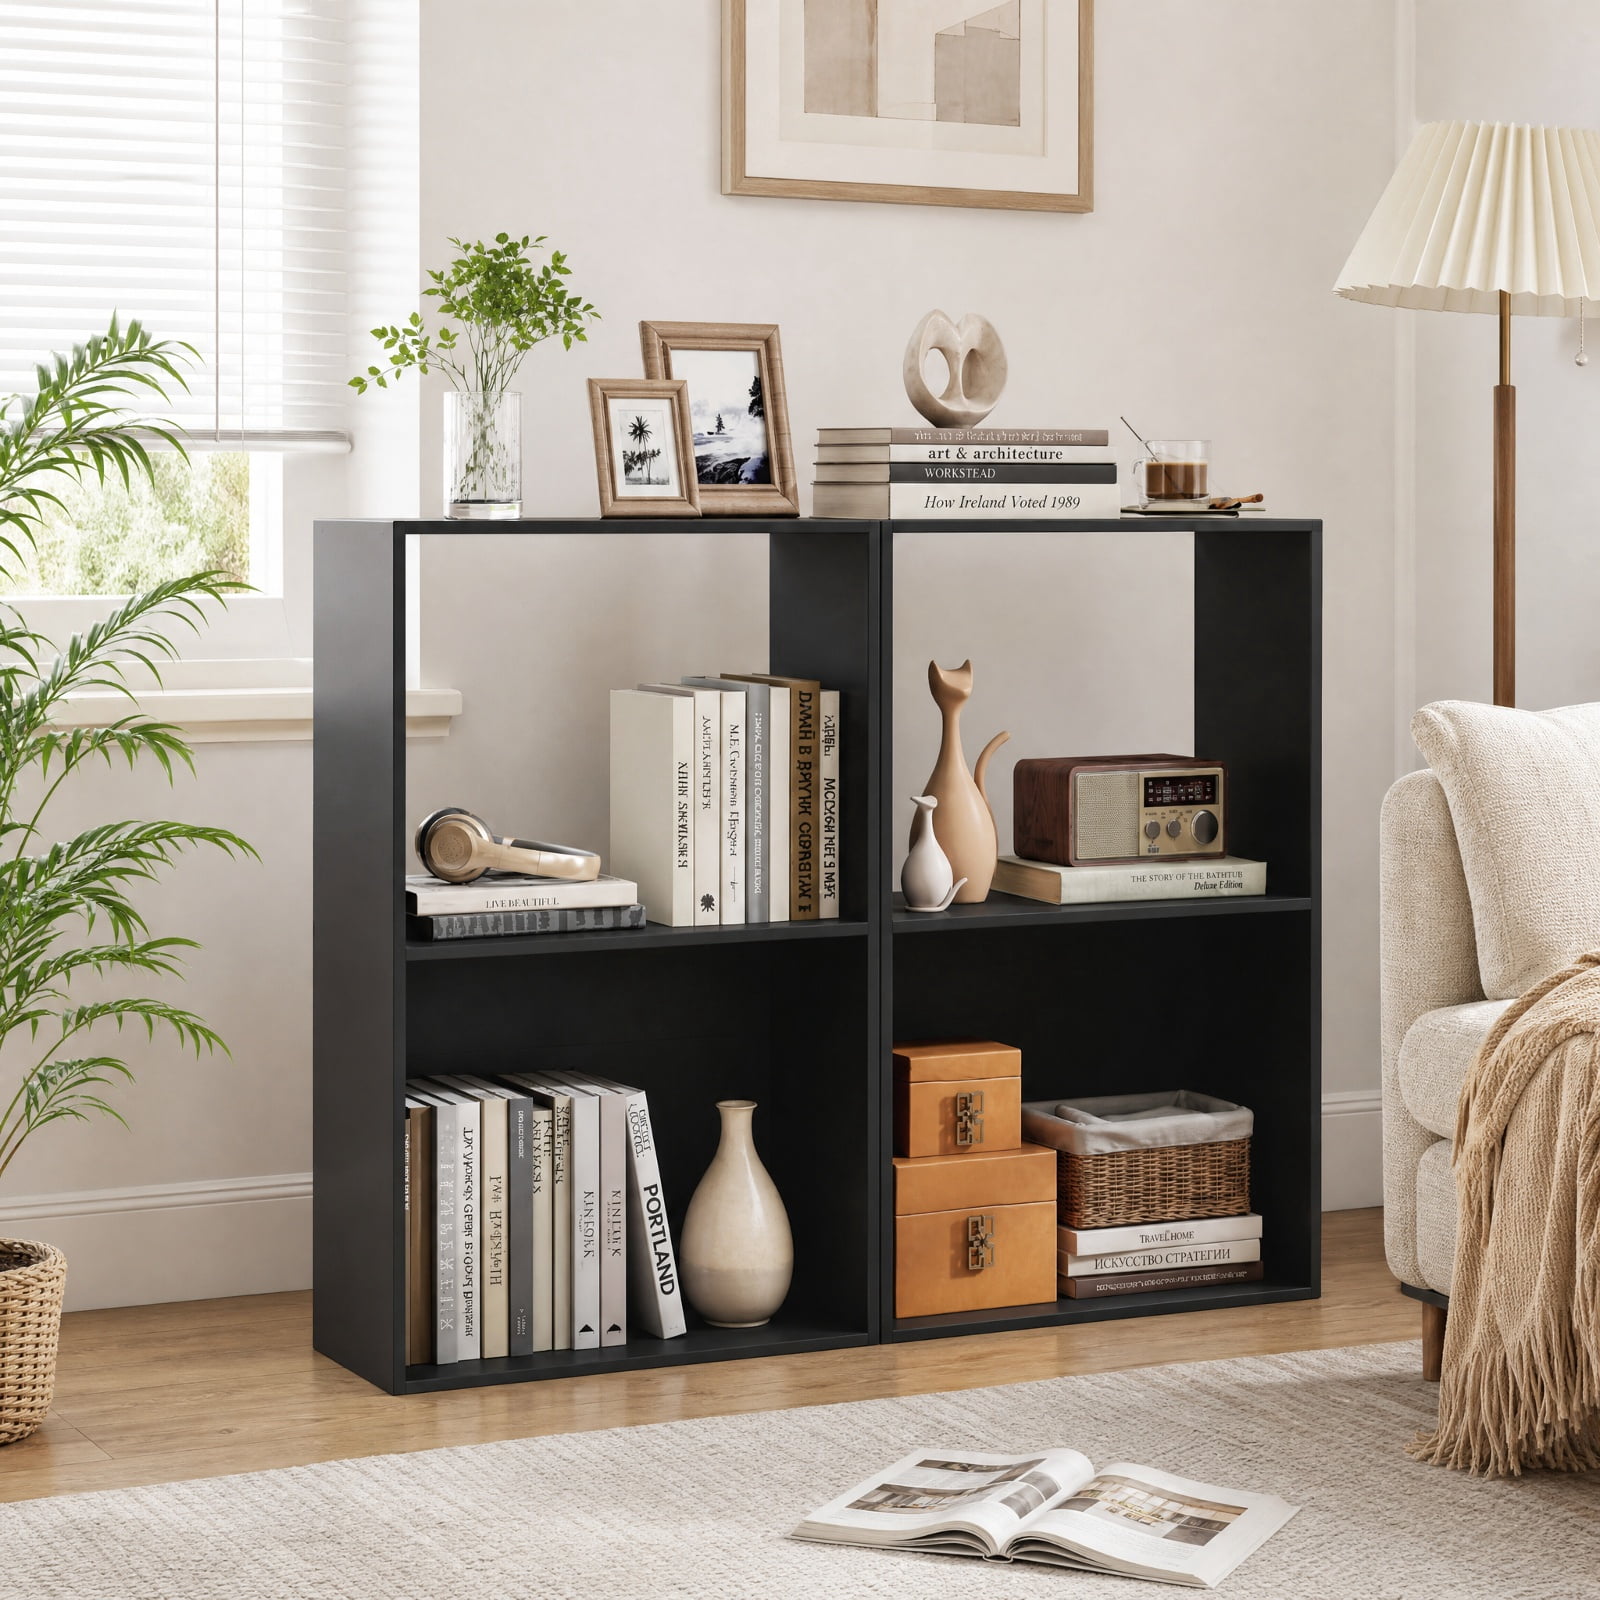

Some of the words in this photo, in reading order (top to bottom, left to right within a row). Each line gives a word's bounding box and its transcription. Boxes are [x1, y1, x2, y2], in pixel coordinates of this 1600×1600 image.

[928, 448, 950, 460] art
[956, 447, 968, 460] &
[973, 447, 1064, 460] architecture
[925, 467, 996, 479] WORKSTEAD
[924, 495, 955, 509] How
[959, 494, 1006, 509] Ireland
[1011, 494, 1048, 509] Voted
[1051, 495, 1081, 510] 1989
[1130, 875, 1147, 883] THE
[1148, 873, 1174, 882] STORY
[1175, 873, 1187, 881] OF
[1187, 872, 1205, 880] THE
[1206, 871, 1243, 879] BATHTUB
[1194, 881, 1218, 890] Deluxe
[1219, 880, 1243, 889] Edition
[486, 899, 507, 909] LIVE
[508, 896, 560, 908] BEAUTIFUL
[643, 1183, 675, 1296] PORTLAND
[1170, 1230, 1195, 1241] HOME
[1094, 1254, 1163, 1270] ИСКУССТВО
[1165, 1248, 1231, 1264] СТРАТЕГИИ
